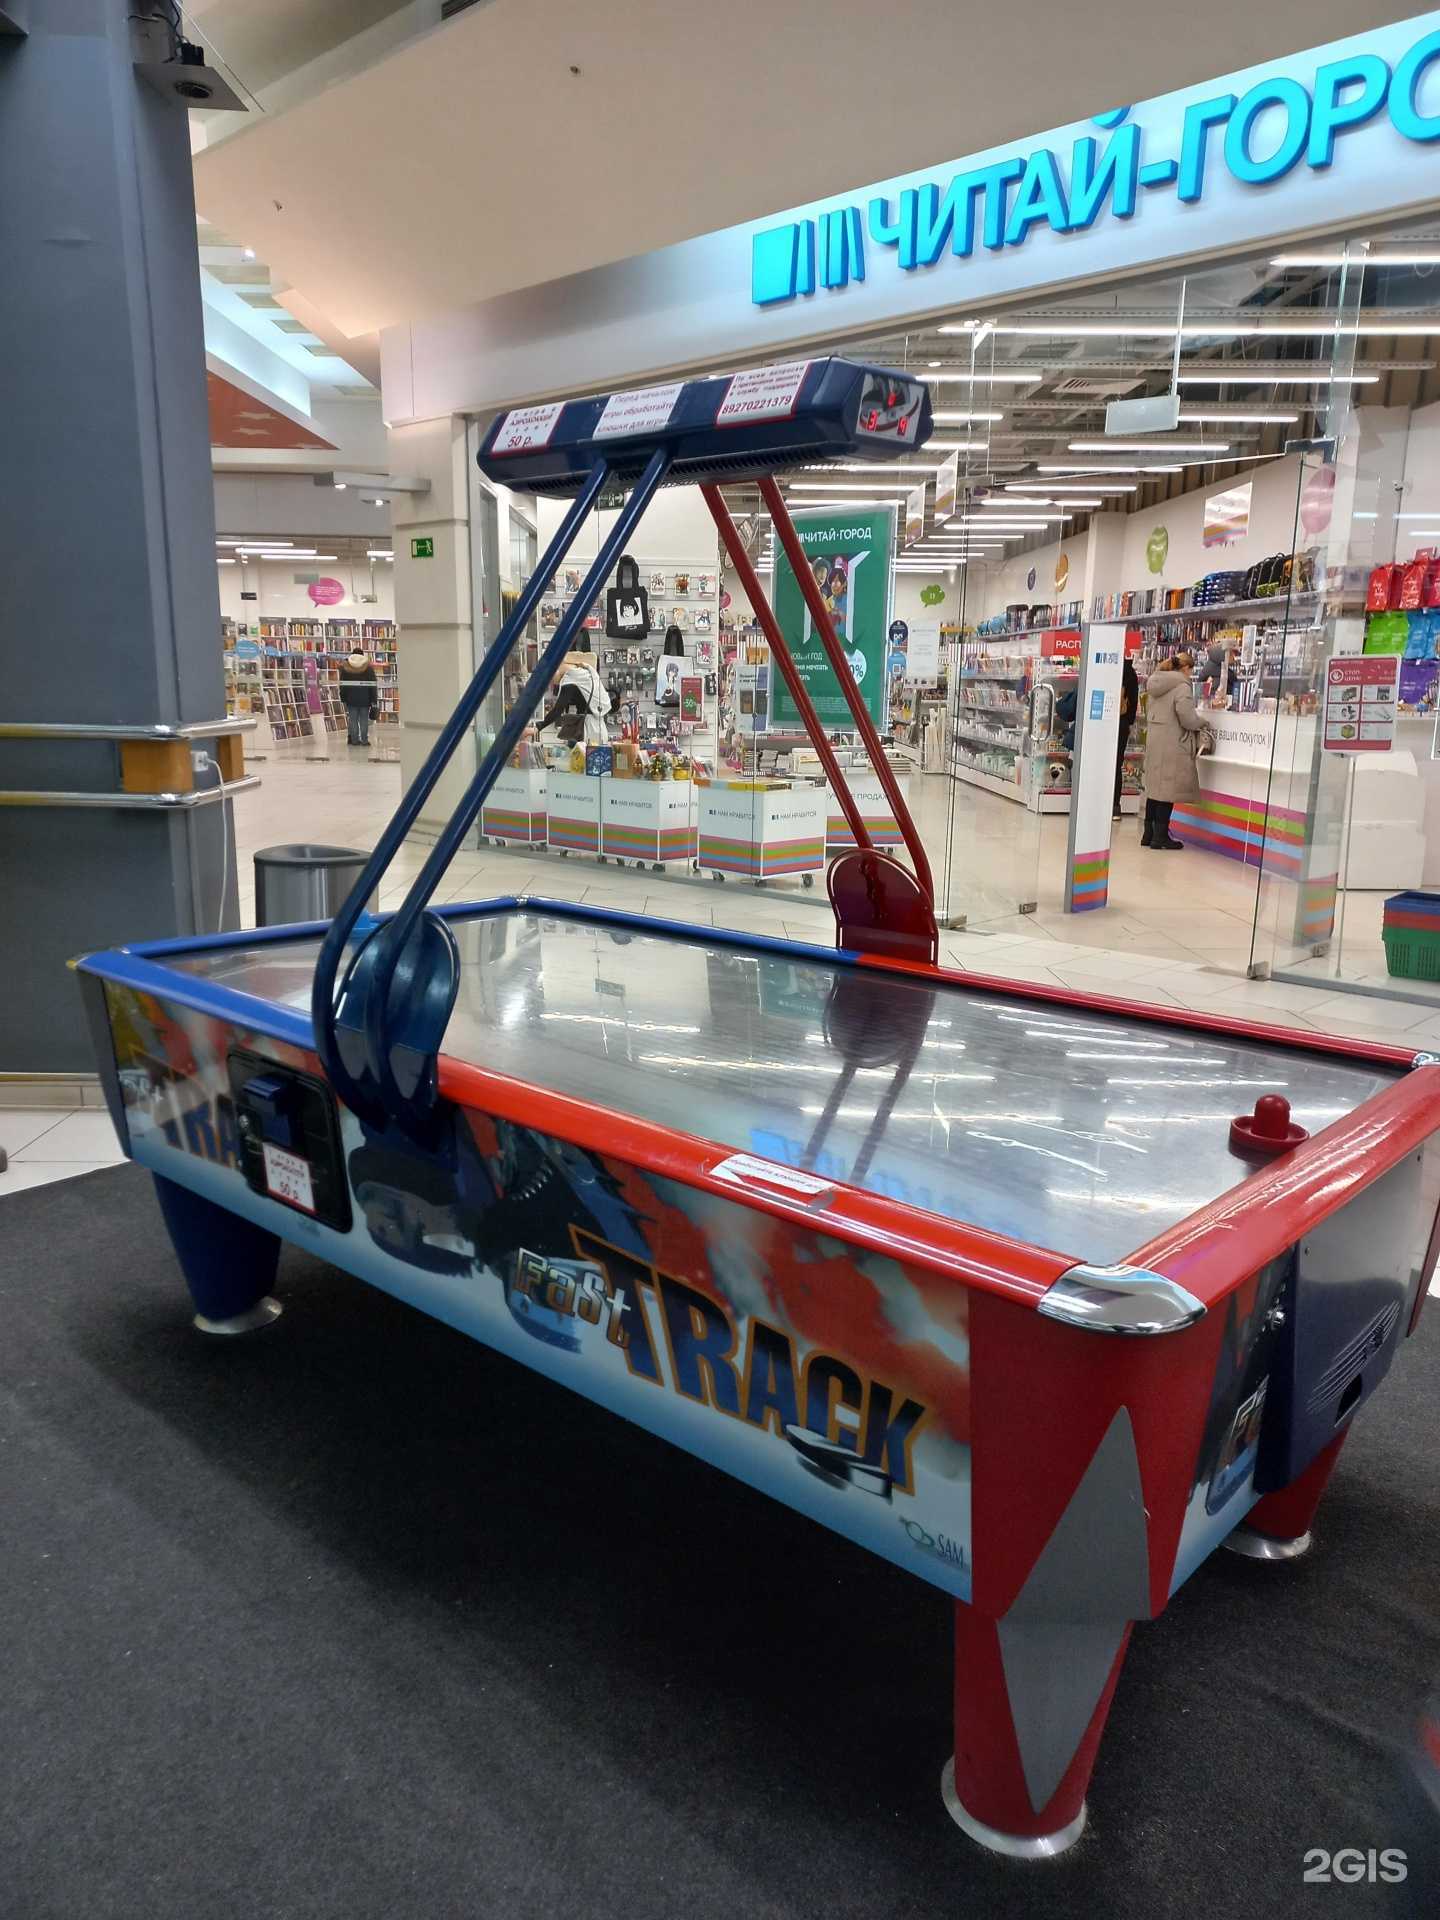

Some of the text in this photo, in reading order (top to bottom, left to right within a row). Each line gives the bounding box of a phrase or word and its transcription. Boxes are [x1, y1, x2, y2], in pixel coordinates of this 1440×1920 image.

[722, 395, 792, 414] 89270221379
[508, 435, 522, 448] 50
[513, 1247, 631, 1349] Fast
[568, 1223, 926, 1497] TRACK
